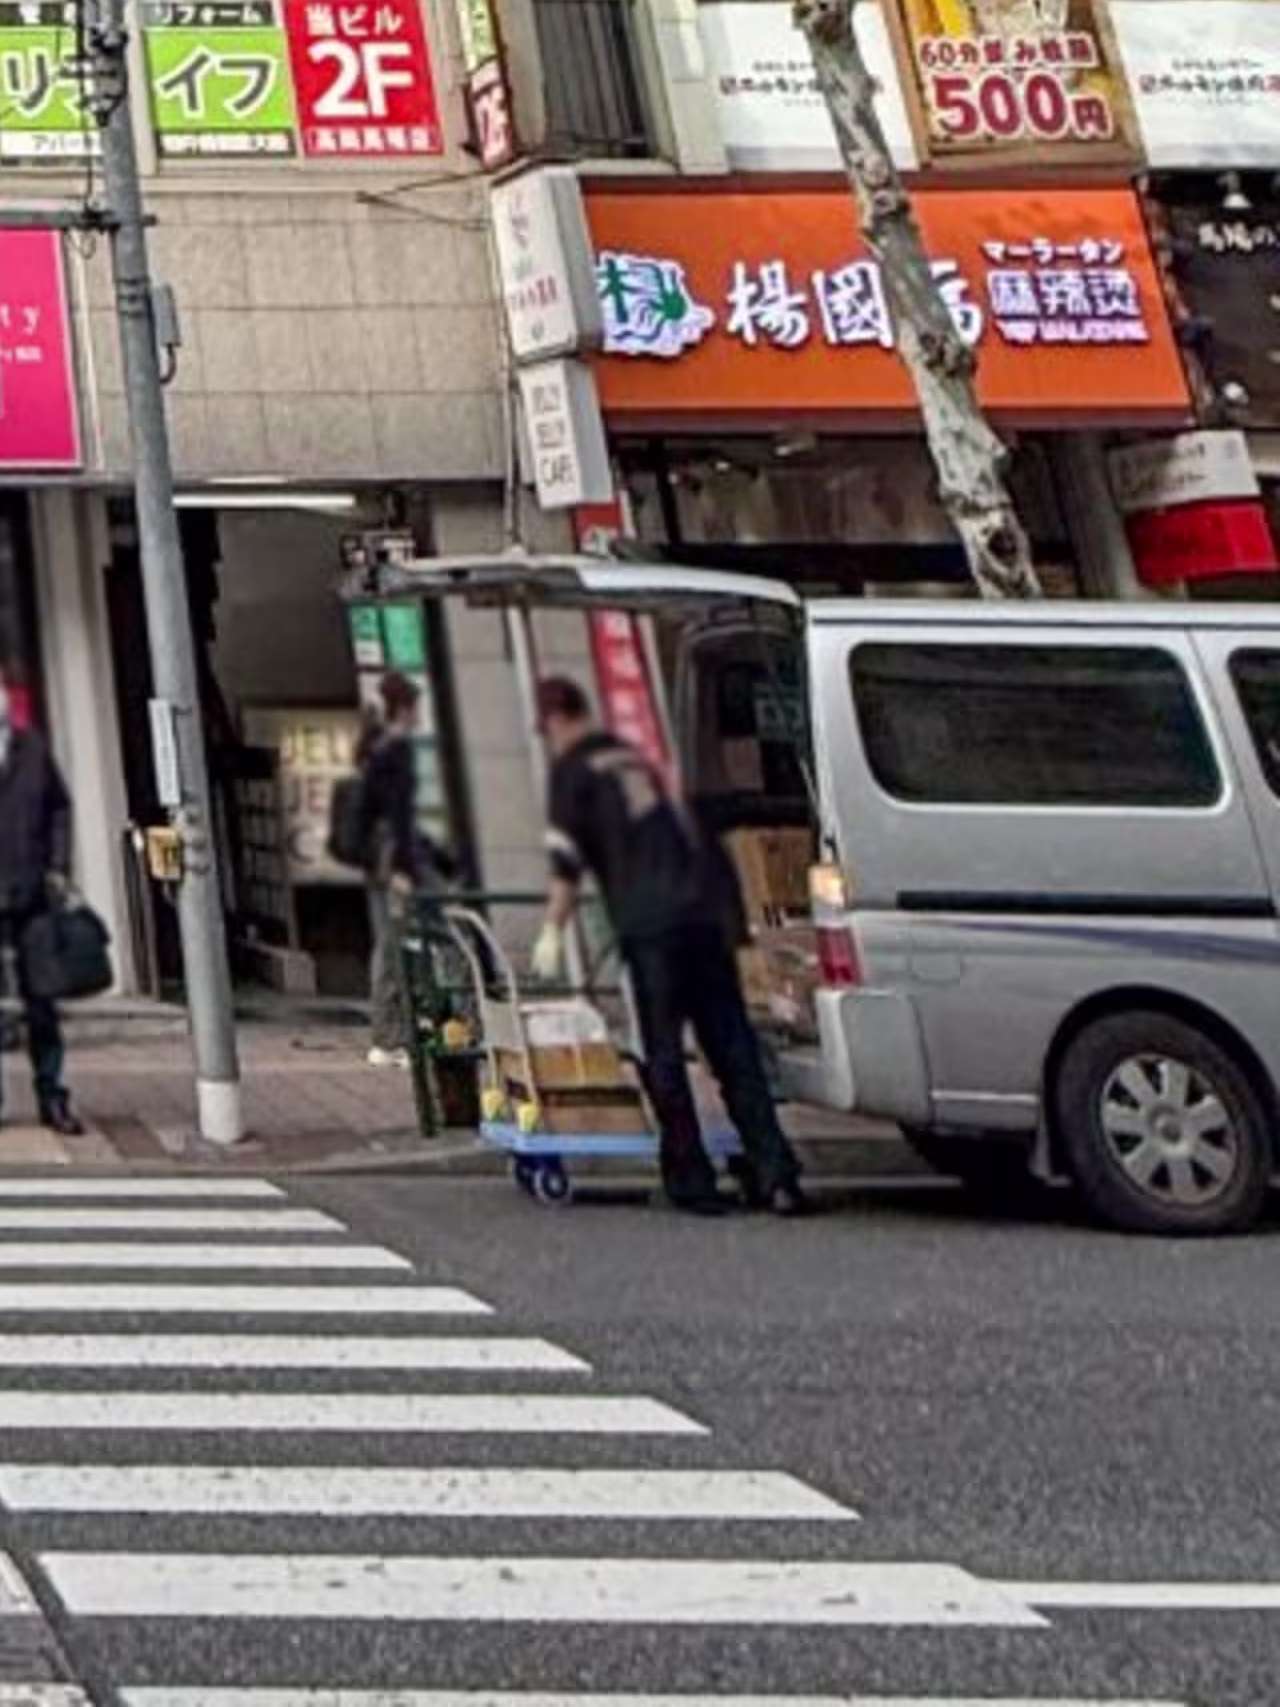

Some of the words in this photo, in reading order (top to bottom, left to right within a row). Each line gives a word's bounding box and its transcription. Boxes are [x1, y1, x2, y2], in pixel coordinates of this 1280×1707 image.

[305, 3, 404, 37] 当ビル
[306, 38, 415, 118] 2F
[930, 73, 1113, 138] 500円
[981, 237, 1124, 266] マーラータン
